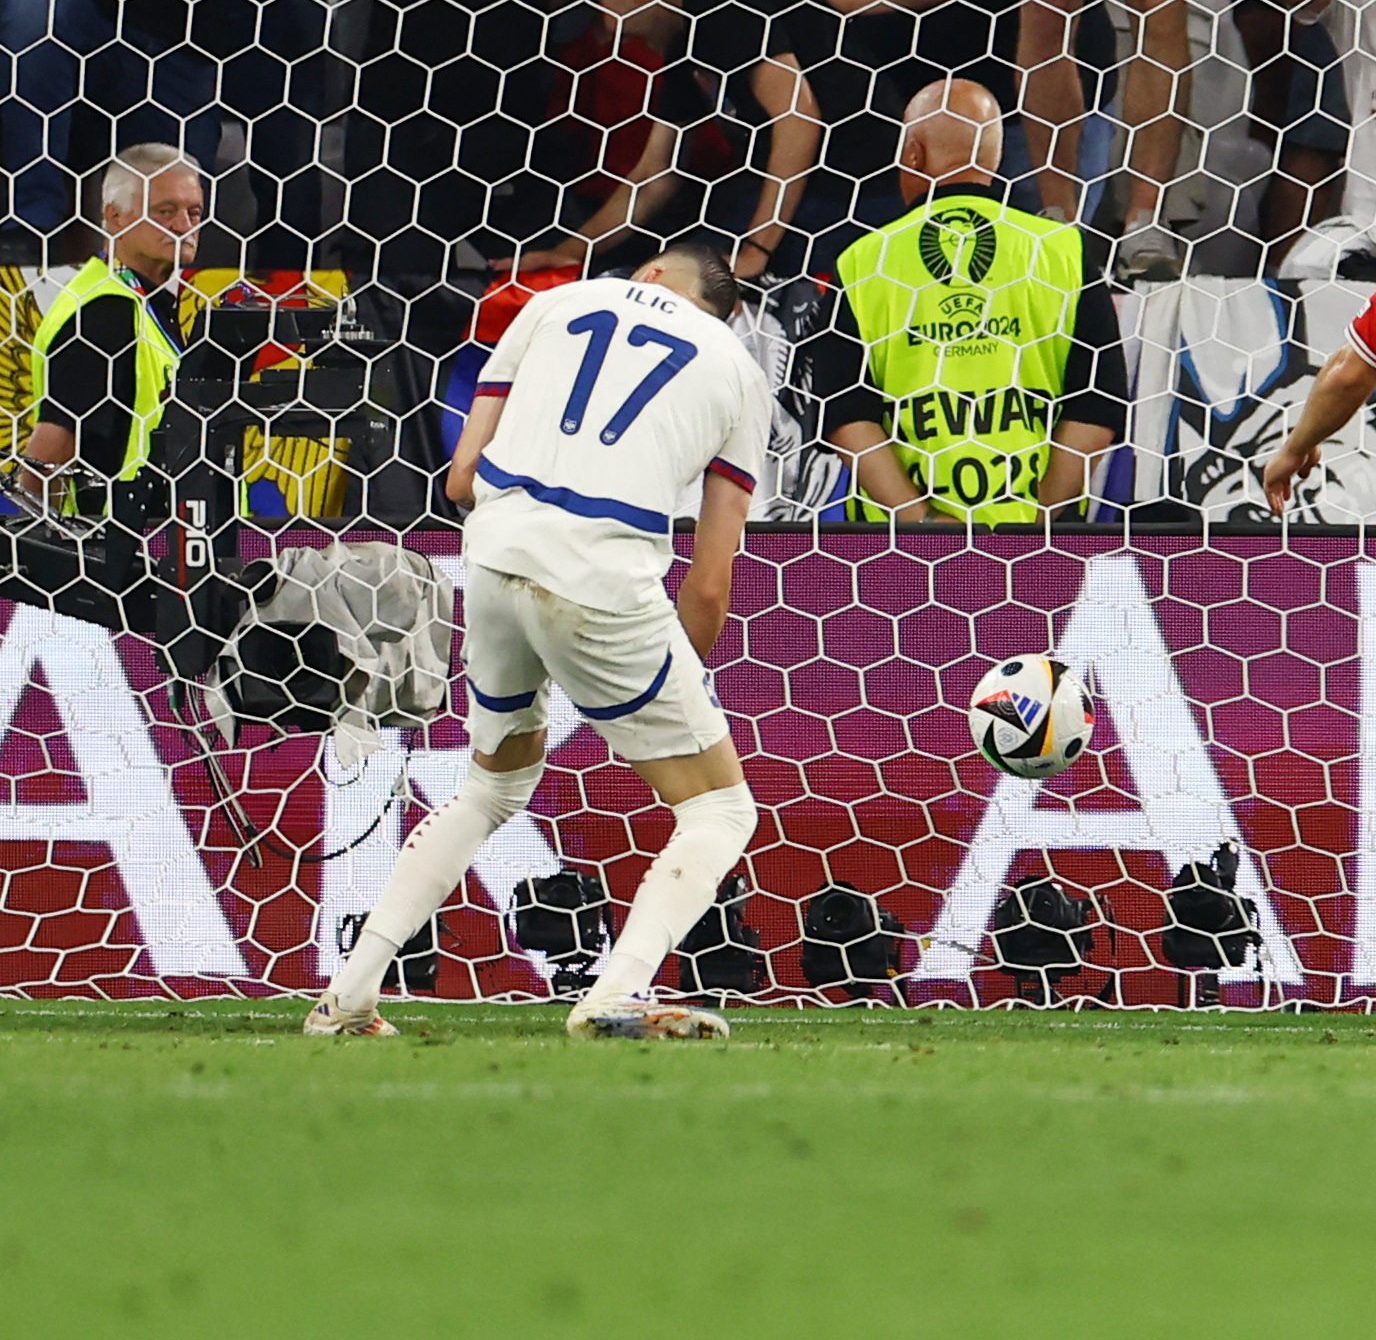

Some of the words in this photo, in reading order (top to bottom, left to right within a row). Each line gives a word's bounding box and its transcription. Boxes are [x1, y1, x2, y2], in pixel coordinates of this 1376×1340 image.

[940, 296, 984, 316] UEFA
[933, 341, 1000, 358] GERMANY
[560, 309, 698, 447] 17
[880, 387, 1053, 443] TEWAR
